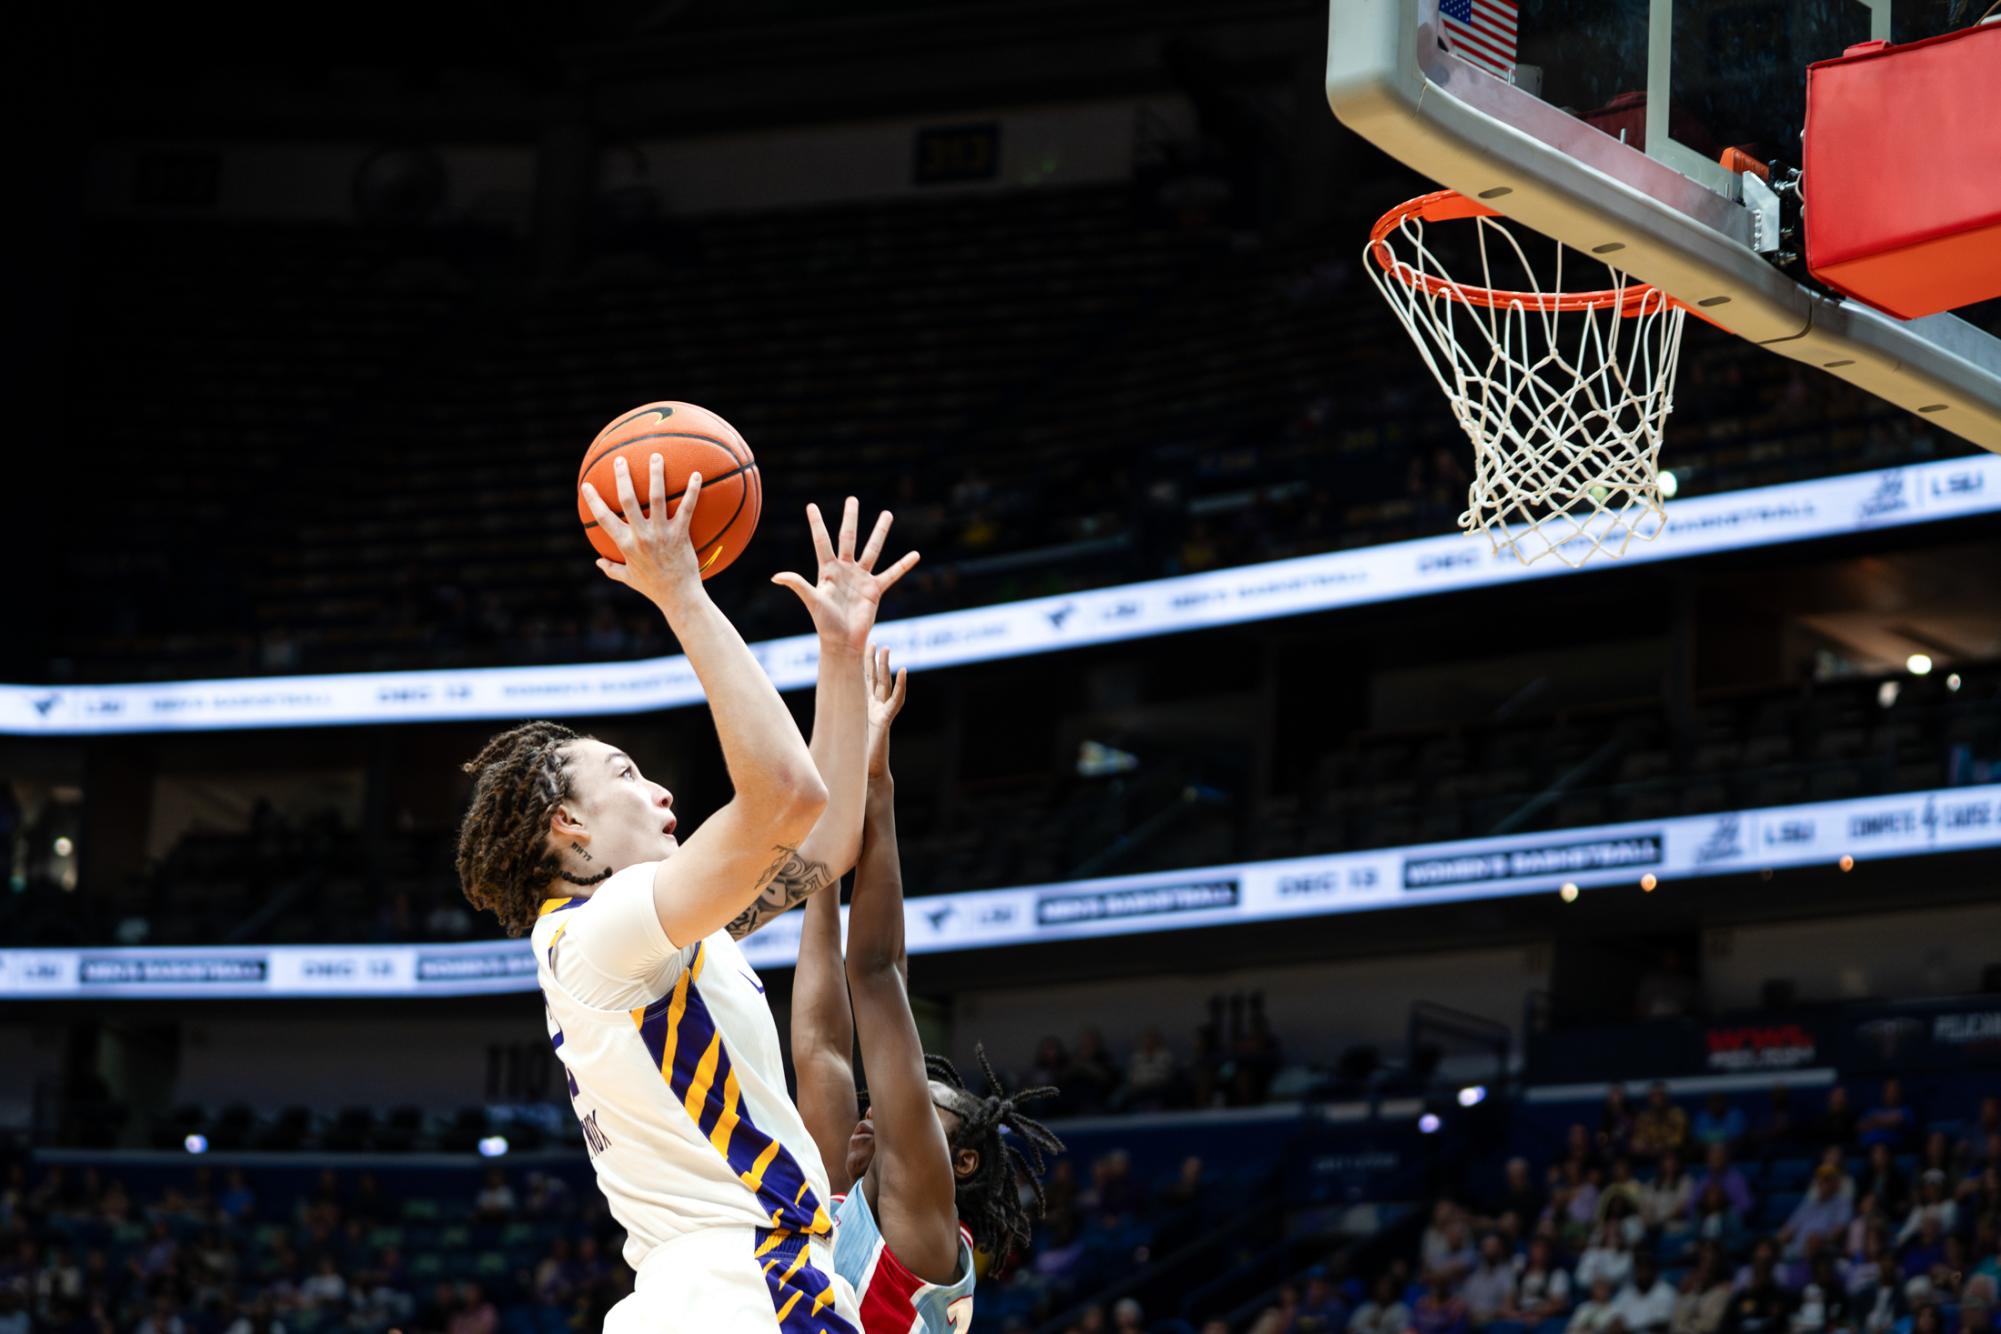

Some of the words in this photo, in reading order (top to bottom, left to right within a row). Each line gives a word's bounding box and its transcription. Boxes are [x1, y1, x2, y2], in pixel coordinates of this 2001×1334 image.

[1931, 469, 1985, 497] LSU
[1763, 817, 1817, 846] LSU
[1277, 873, 1337, 895] DEC
[1408, 853, 1507, 886] WOMEN'S
[1510, 839, 1658, 873] BASKETBALL
[1041, 897, 1101, 921] MEN'S
[1105, 882, 1234, 916] BASKETBALL
